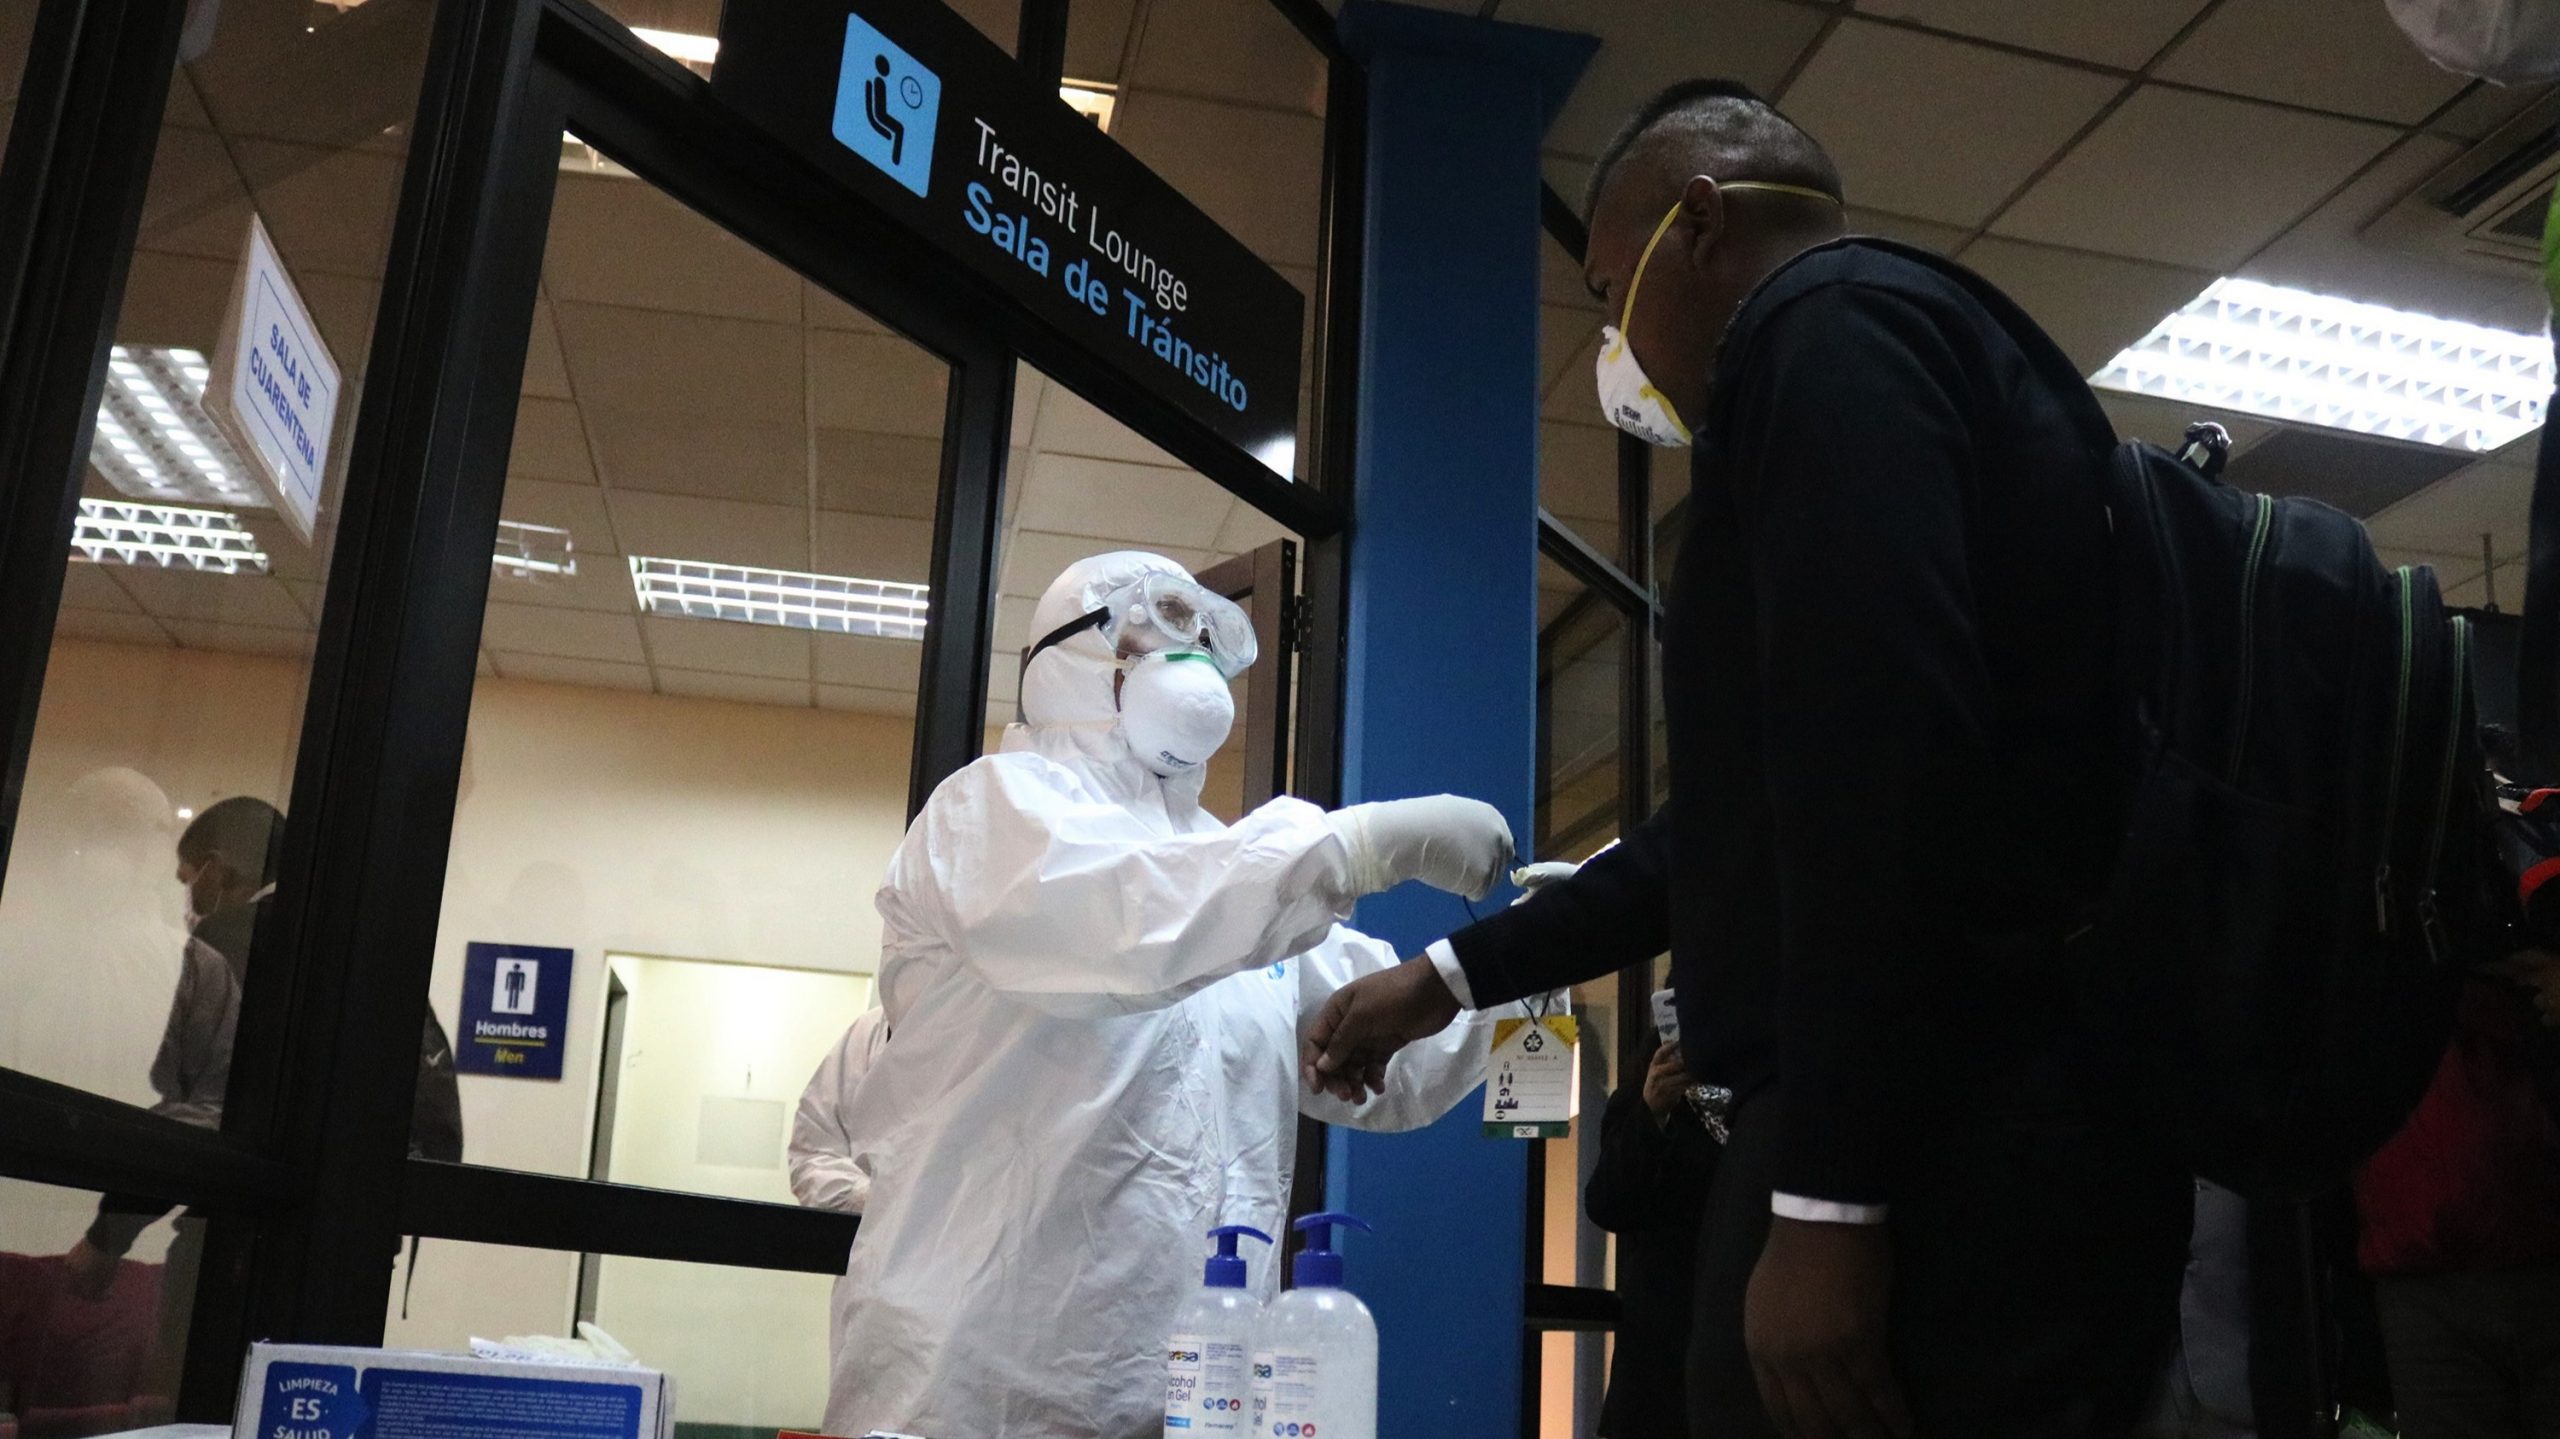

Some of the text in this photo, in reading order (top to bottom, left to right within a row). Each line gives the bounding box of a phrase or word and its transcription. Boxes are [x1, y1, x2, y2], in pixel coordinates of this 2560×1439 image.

[975, 117, 1189, 312] Transit Lounge
[963, 182, 1248, 413] Sala de Tránsito
[270, 323, 312, 410] SALA DE
[250, 346, 315, 473] CUARENTENA
[475, 1020, 548, 1039] Hombres
[495, 1049, 525, 1064] Men
[279, 1378, 338, 1396] LIMPIEZA
[291, 1397, 321, 1421] ES
